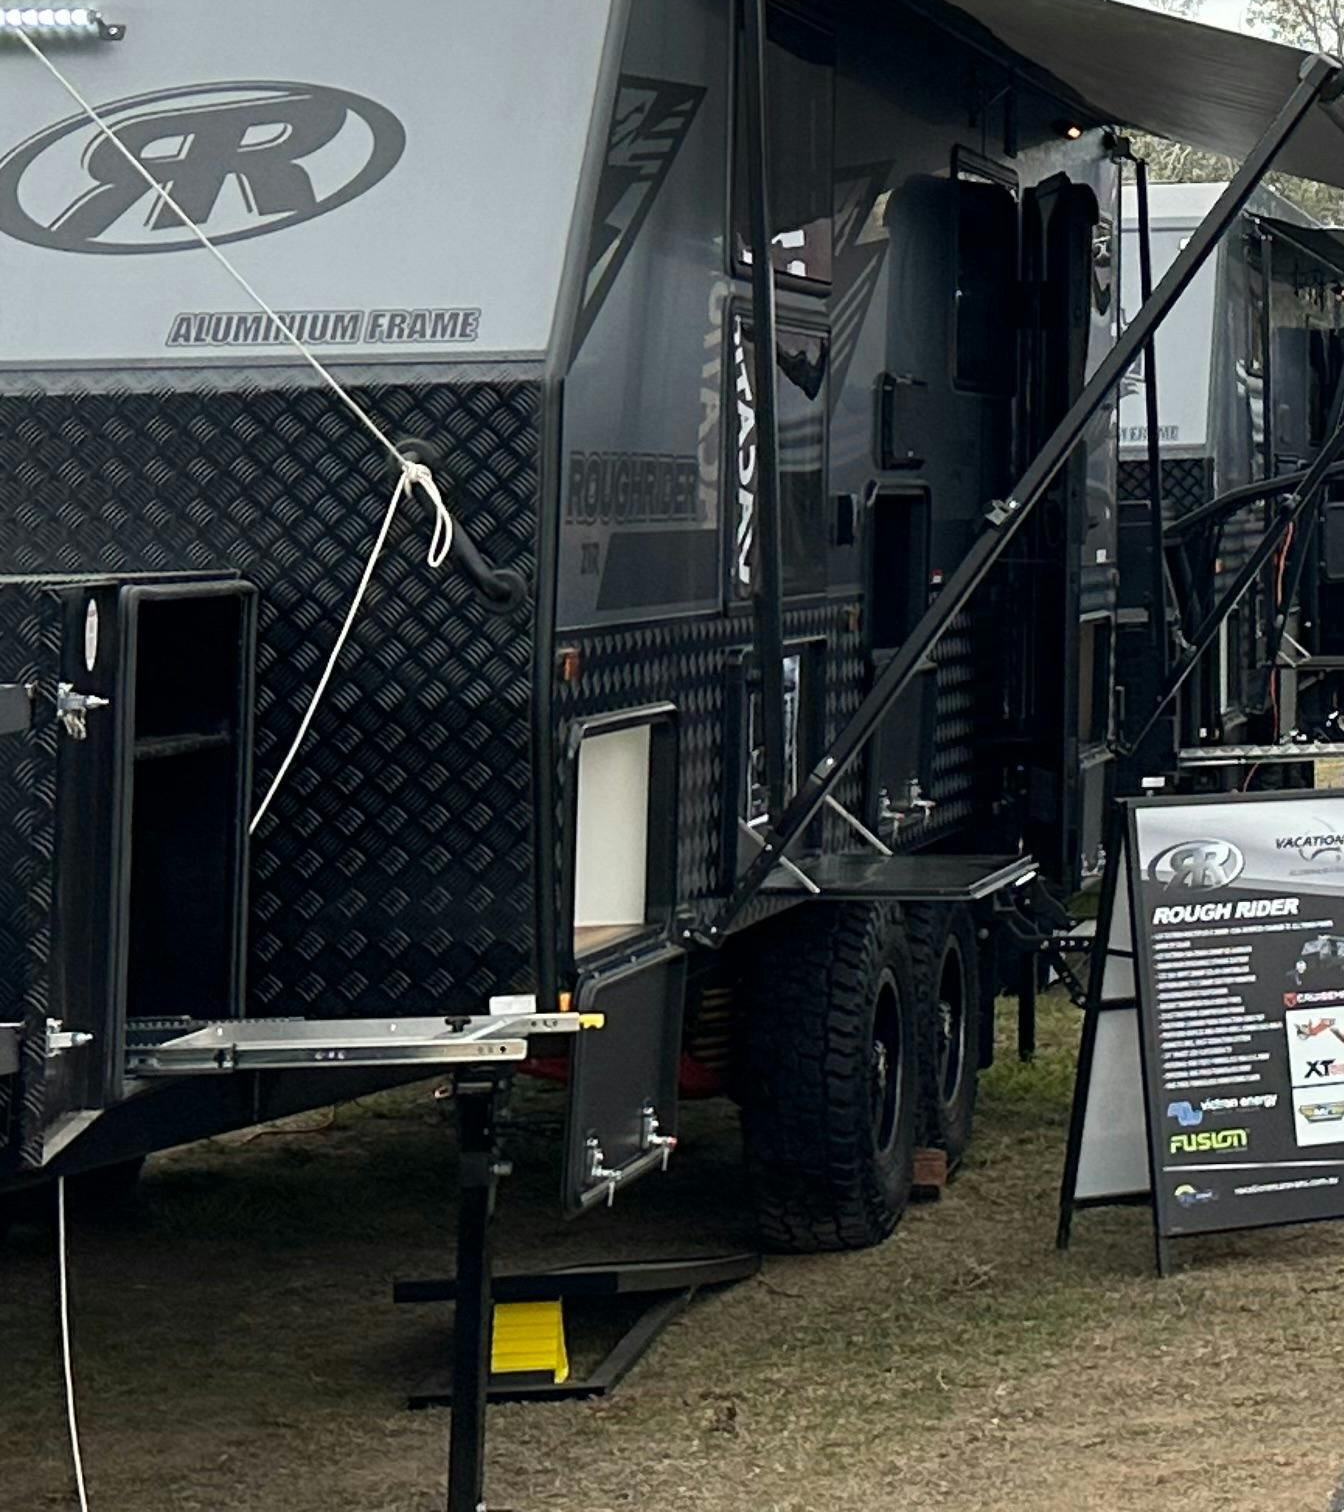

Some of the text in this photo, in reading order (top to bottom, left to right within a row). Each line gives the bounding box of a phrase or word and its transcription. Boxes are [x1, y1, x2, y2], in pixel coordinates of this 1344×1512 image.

[165, 308, 481, 347] ALUMINIUM FRAME
[1152, 897, 1300, 926] ROUGH RIDER
[1304, 1059, 1336, 1078] XT
[1200, 1096, 1239, 1111] victron
[1239, 1093, 1279, 1109] energy
[1169, 1128, 1249, 1155] FUSION
